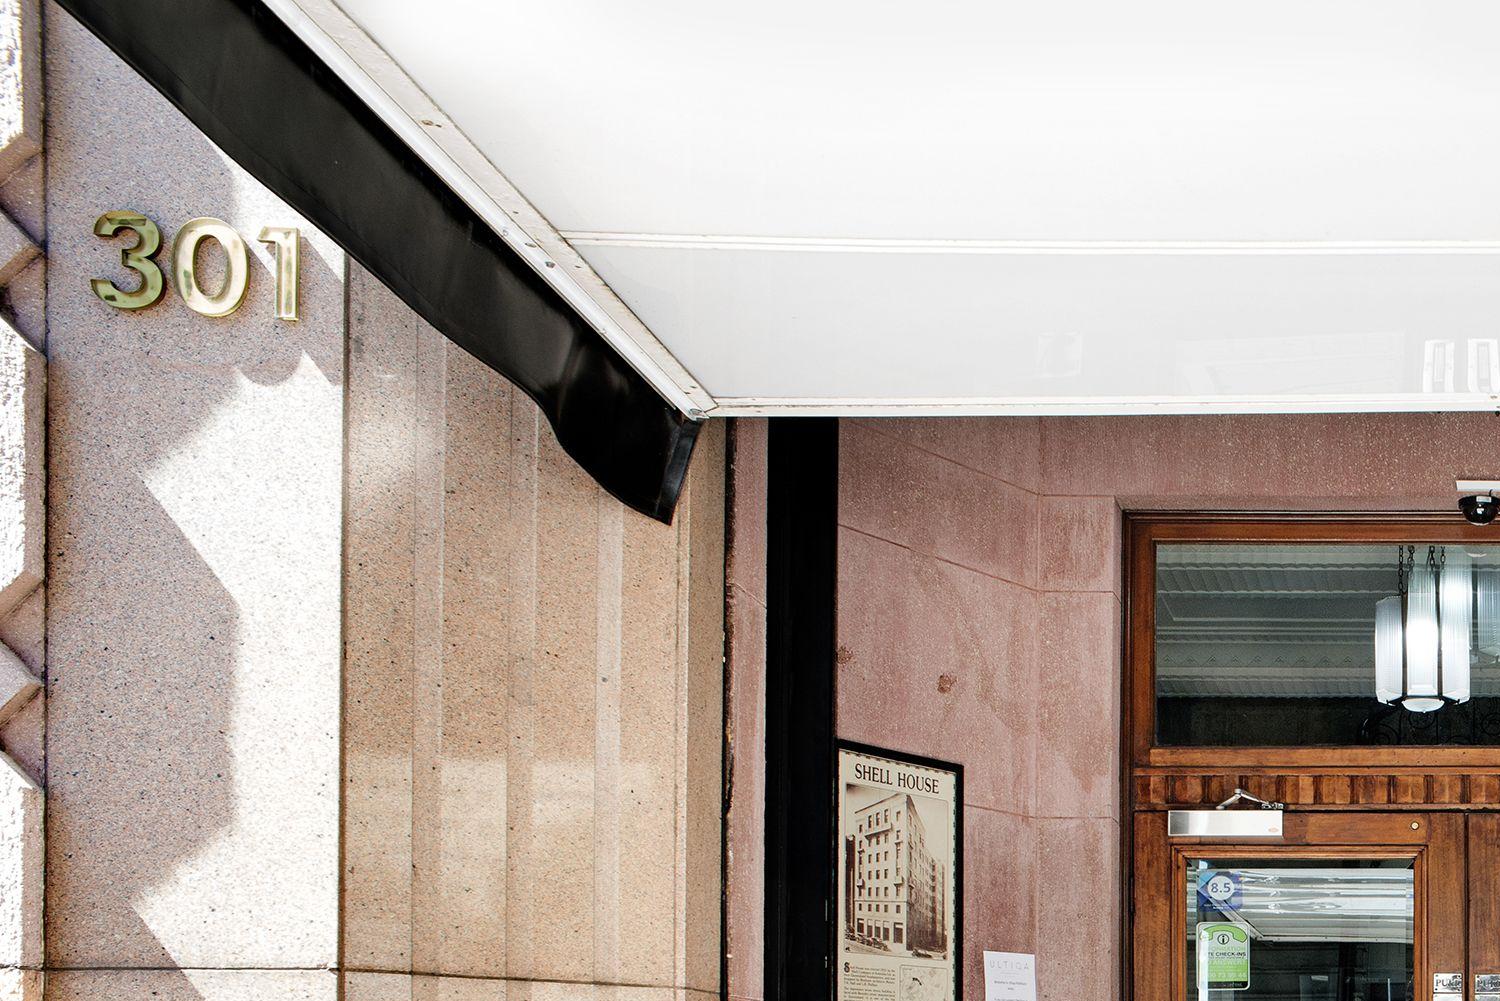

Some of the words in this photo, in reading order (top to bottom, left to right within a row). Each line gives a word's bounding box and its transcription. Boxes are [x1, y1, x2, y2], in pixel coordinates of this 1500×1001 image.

[90, 209, 302, 322] 301
[855, 763, 893, 786] SHELL
[897, 772, 940, 794] HOUSE
[1211, 883, 1230, 892] 8.5
[990, 960, 1029, 969] ULTIQA
